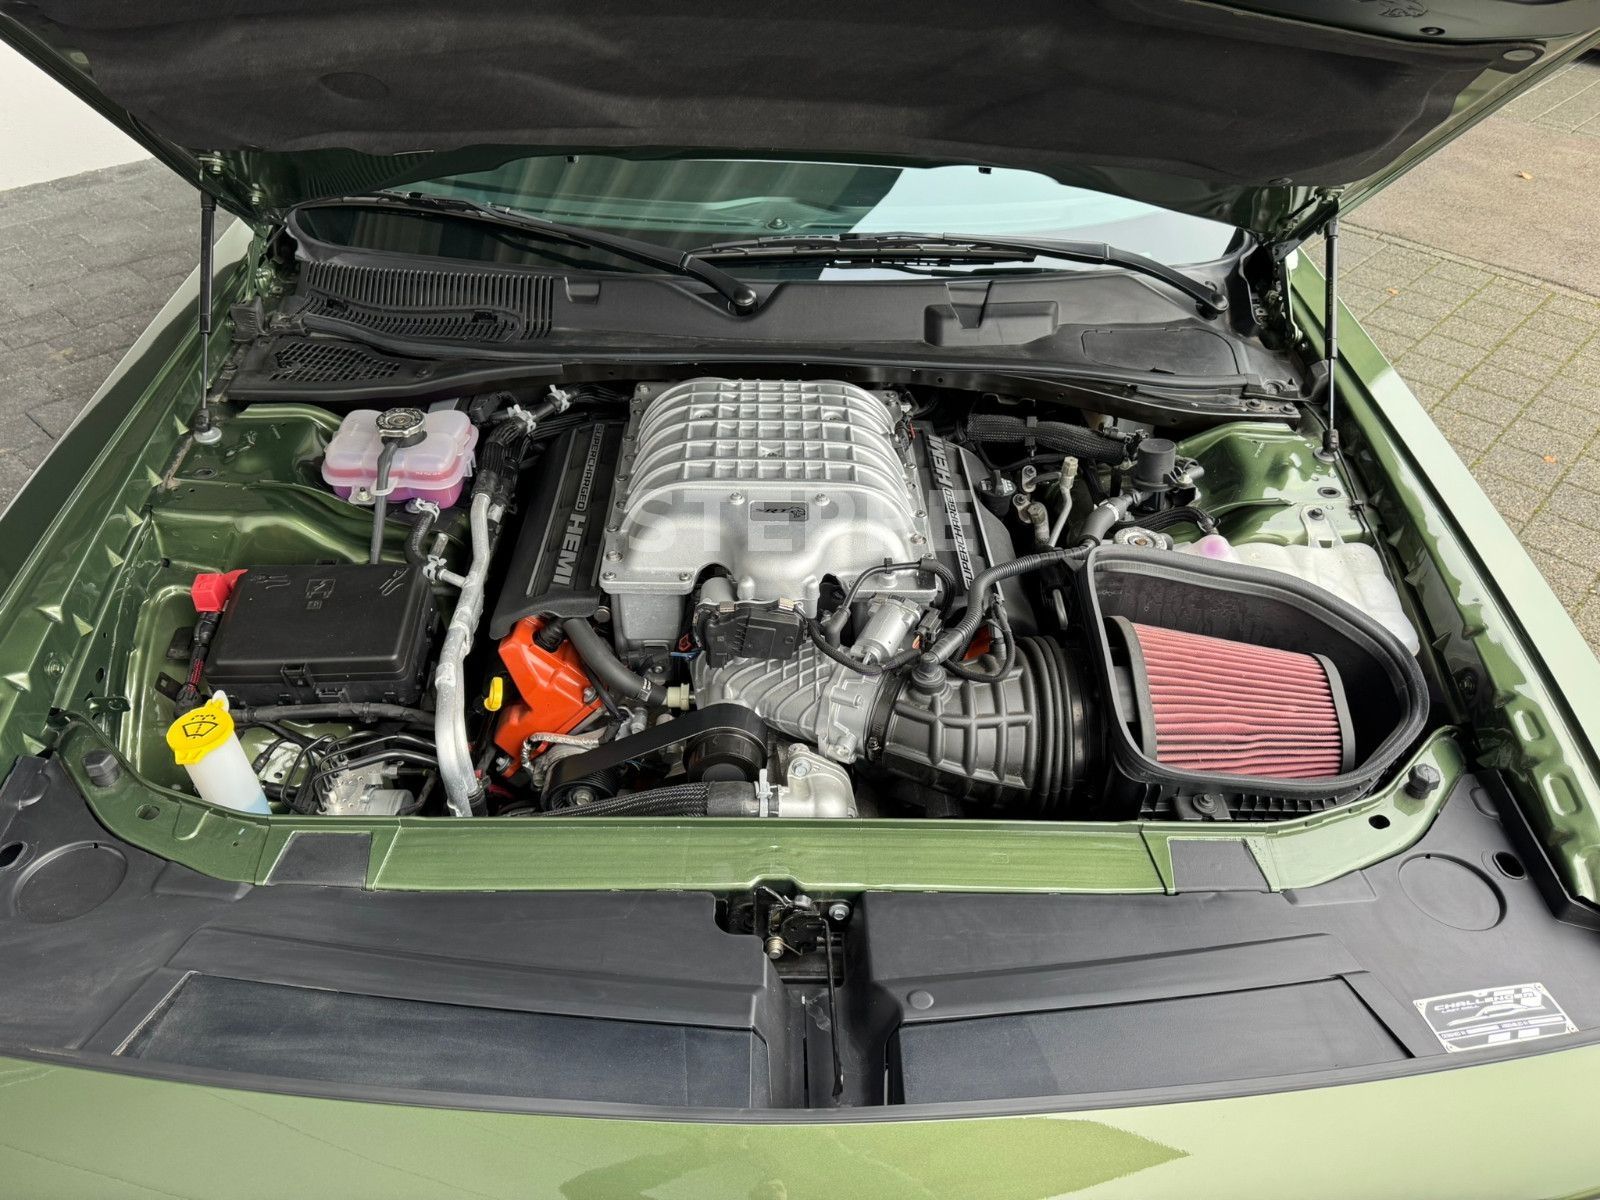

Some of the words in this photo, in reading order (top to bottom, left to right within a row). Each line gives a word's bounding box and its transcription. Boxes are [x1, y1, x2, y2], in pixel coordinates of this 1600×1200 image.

[576, 425, 604, 510] SUPERCHARGED
[928, 434, 953, 487] HEMI
[553, 513, 586, 586] HEMI
